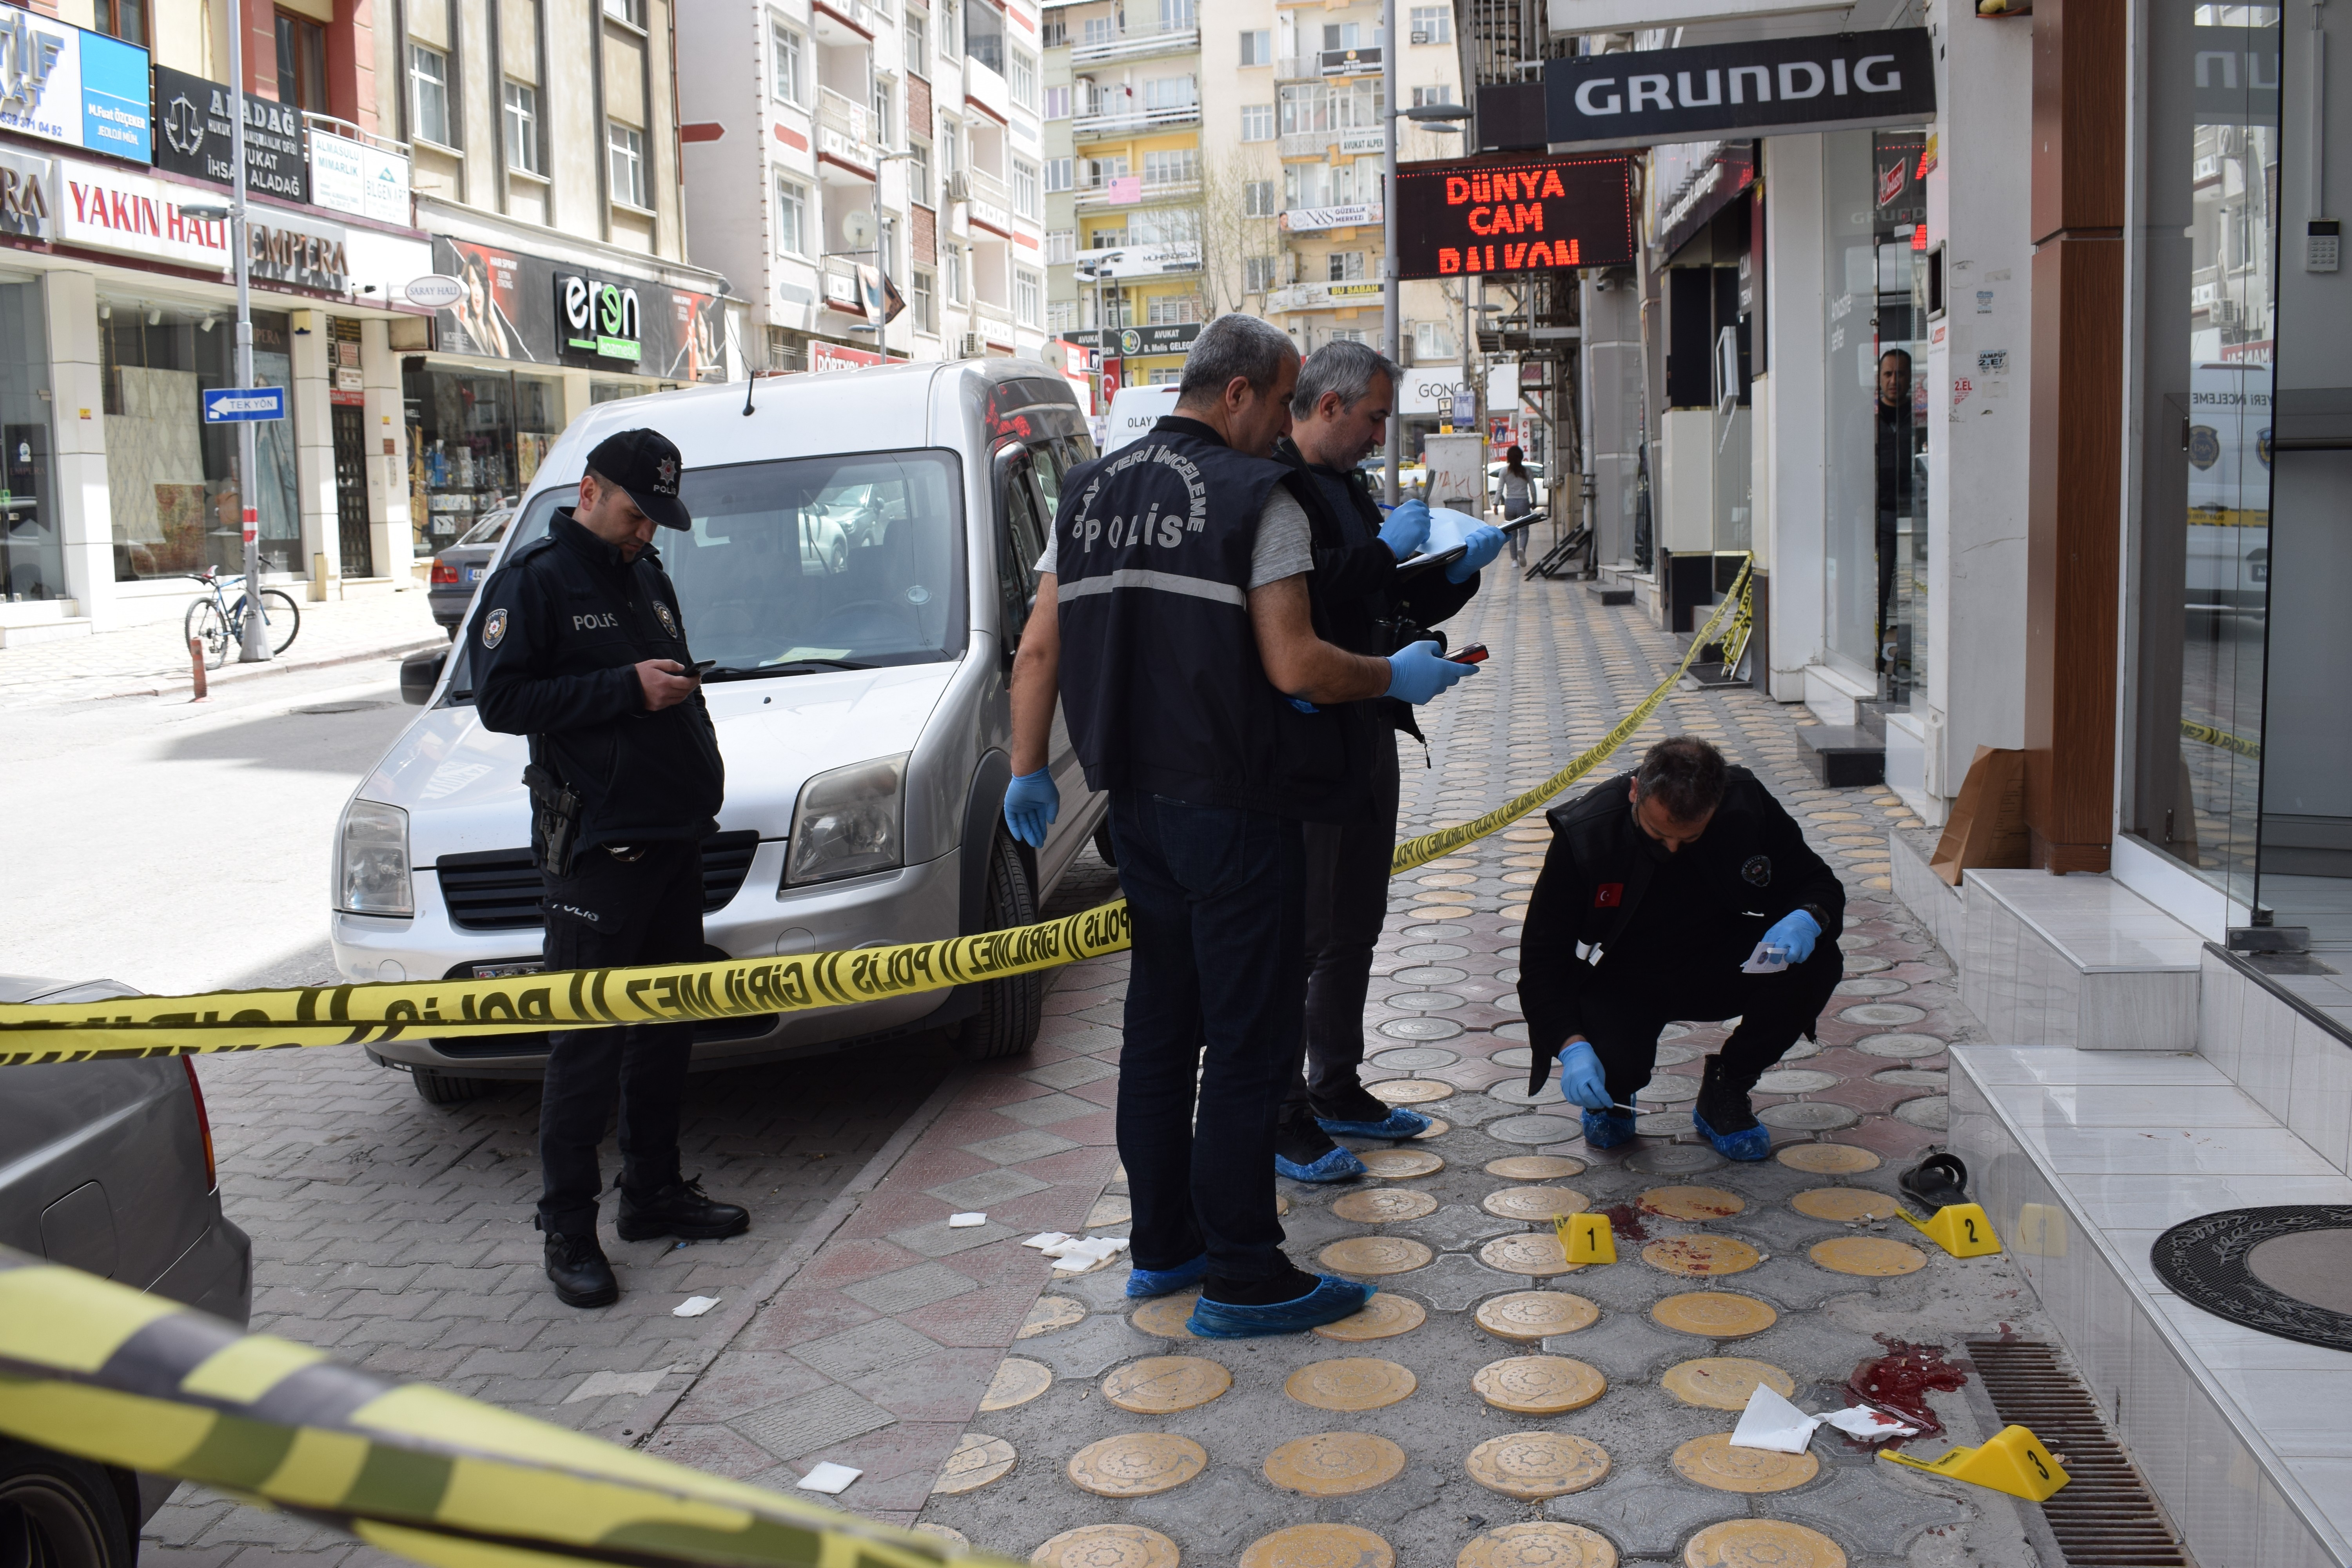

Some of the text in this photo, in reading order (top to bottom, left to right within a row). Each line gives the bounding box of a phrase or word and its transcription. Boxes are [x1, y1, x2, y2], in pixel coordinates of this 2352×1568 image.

[1575, 54, 1901, 116] GRUNDIG
[88, 103, 146, 130] M.Fuat ÖZÇEKER
[52, 125, 62, 137] 52
[208, 119, 231, 137] HUKUK
[244, 129, 281, 152] ANIŞMANLIK
[1344, 140, 1365, 150] AVUKAT
[207, 154, 236, 180] İHSA
[250, 169, 300, 196] ALADAĞ
[69, 181, 160, 238] YAKIN
[166, 202, 226, 250] HALI
[1468, 202, 1543, 235] CAM
[410, 284, 434, 296] SARAY
[1332, 285, 1379, 294] BU SABAH
[600, 339, 639, 358] kozmetik
[1078, 329, 1180, 344] AVUKA AVUKAT
[1144, 345, 1151, 353] B.
[1152, 343, 1168, 352] Melis
[1955, 381, 1973, 390] 2.EL
[230, 398, 273, 410] TEK YÖN
[1127, 417, 1152, 428] OLAY
[1105, 445, 1154, 477] YERİ
[1073, 477, 1099, 539] OLAY
[1587, 1227, 1595, 1251] 1
[1965, 1219, 1978, 1243] 2
[2027, 1450, 2051, 1480] 3
